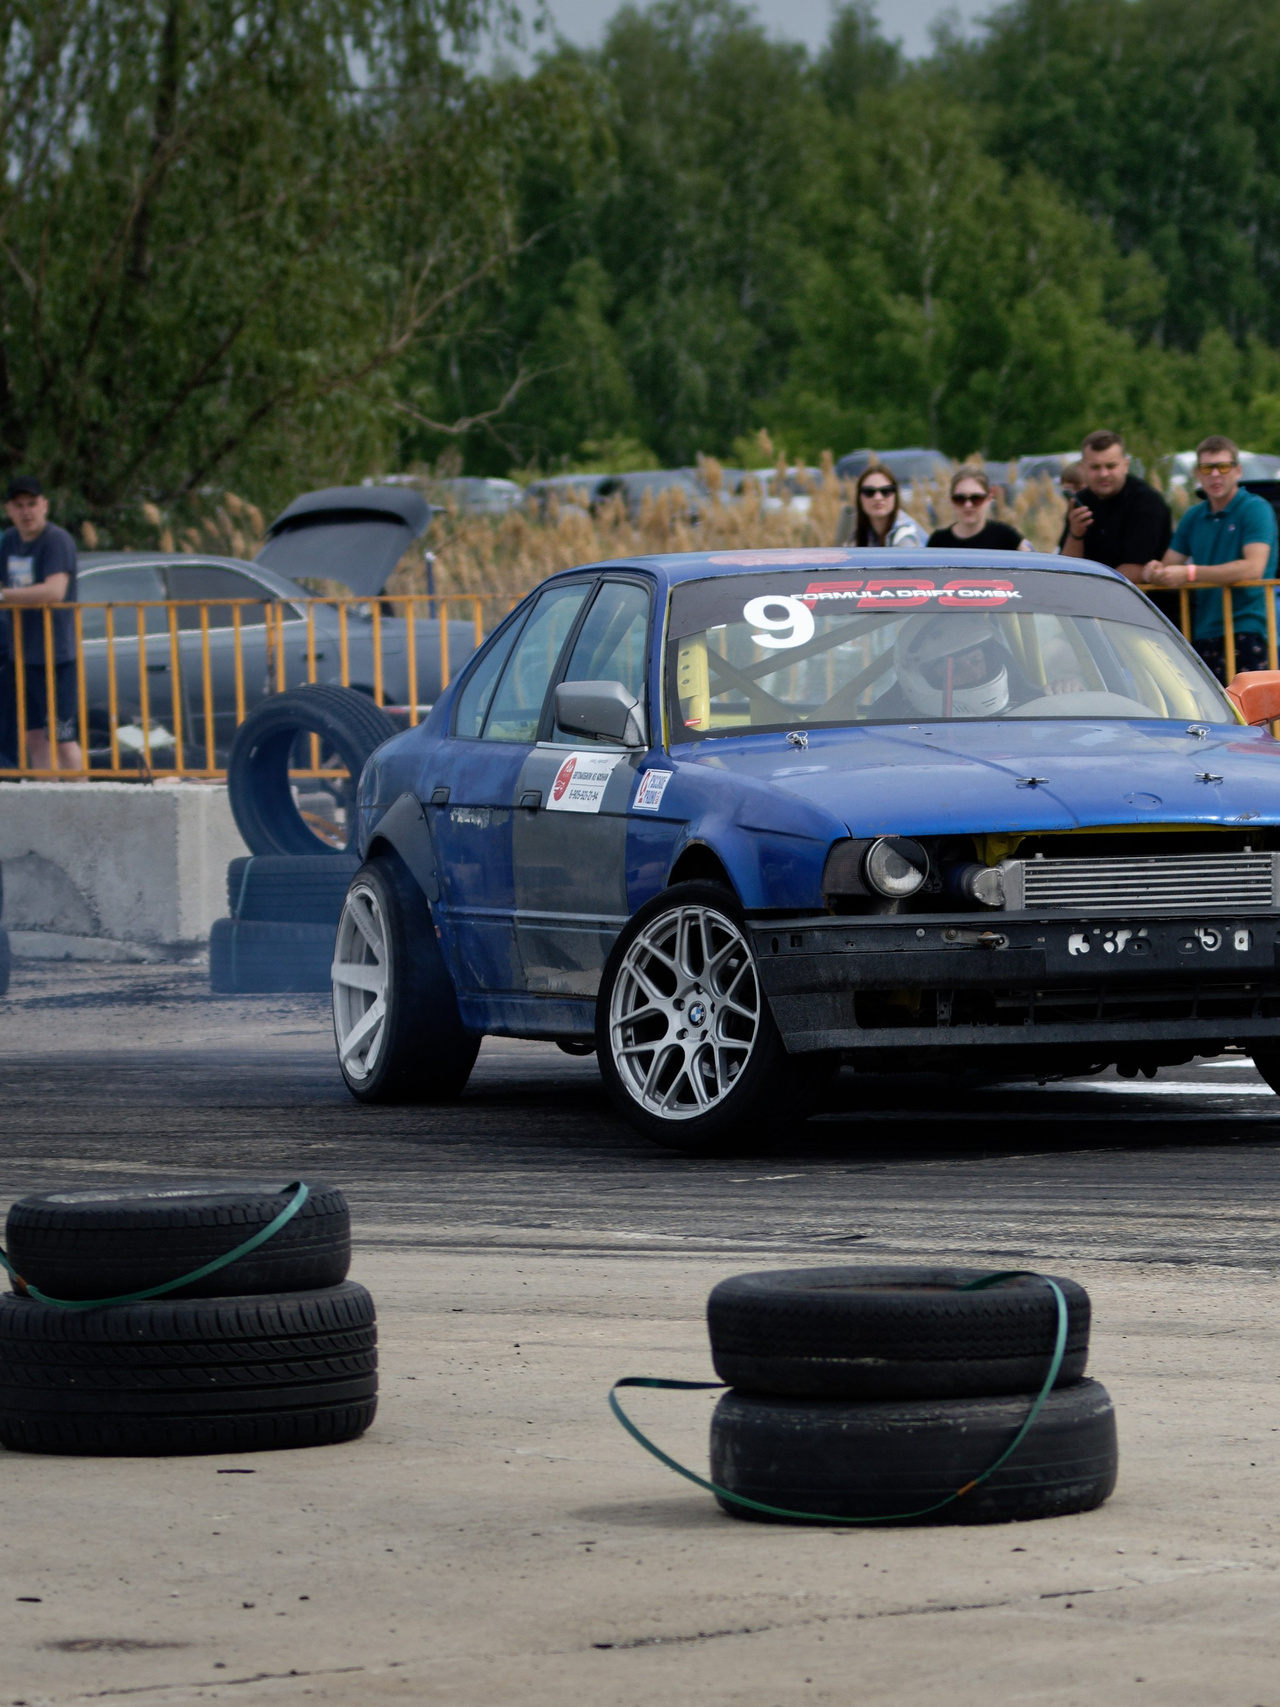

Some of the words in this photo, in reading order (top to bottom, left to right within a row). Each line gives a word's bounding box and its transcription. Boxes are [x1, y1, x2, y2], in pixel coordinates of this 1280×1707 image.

[790, 590, 896, 601] FORMULA
[896, 589, 955, 598] DRIFT
[957, 589, 1023, 598] OMSK
[743, 595, 815, 649] 9
